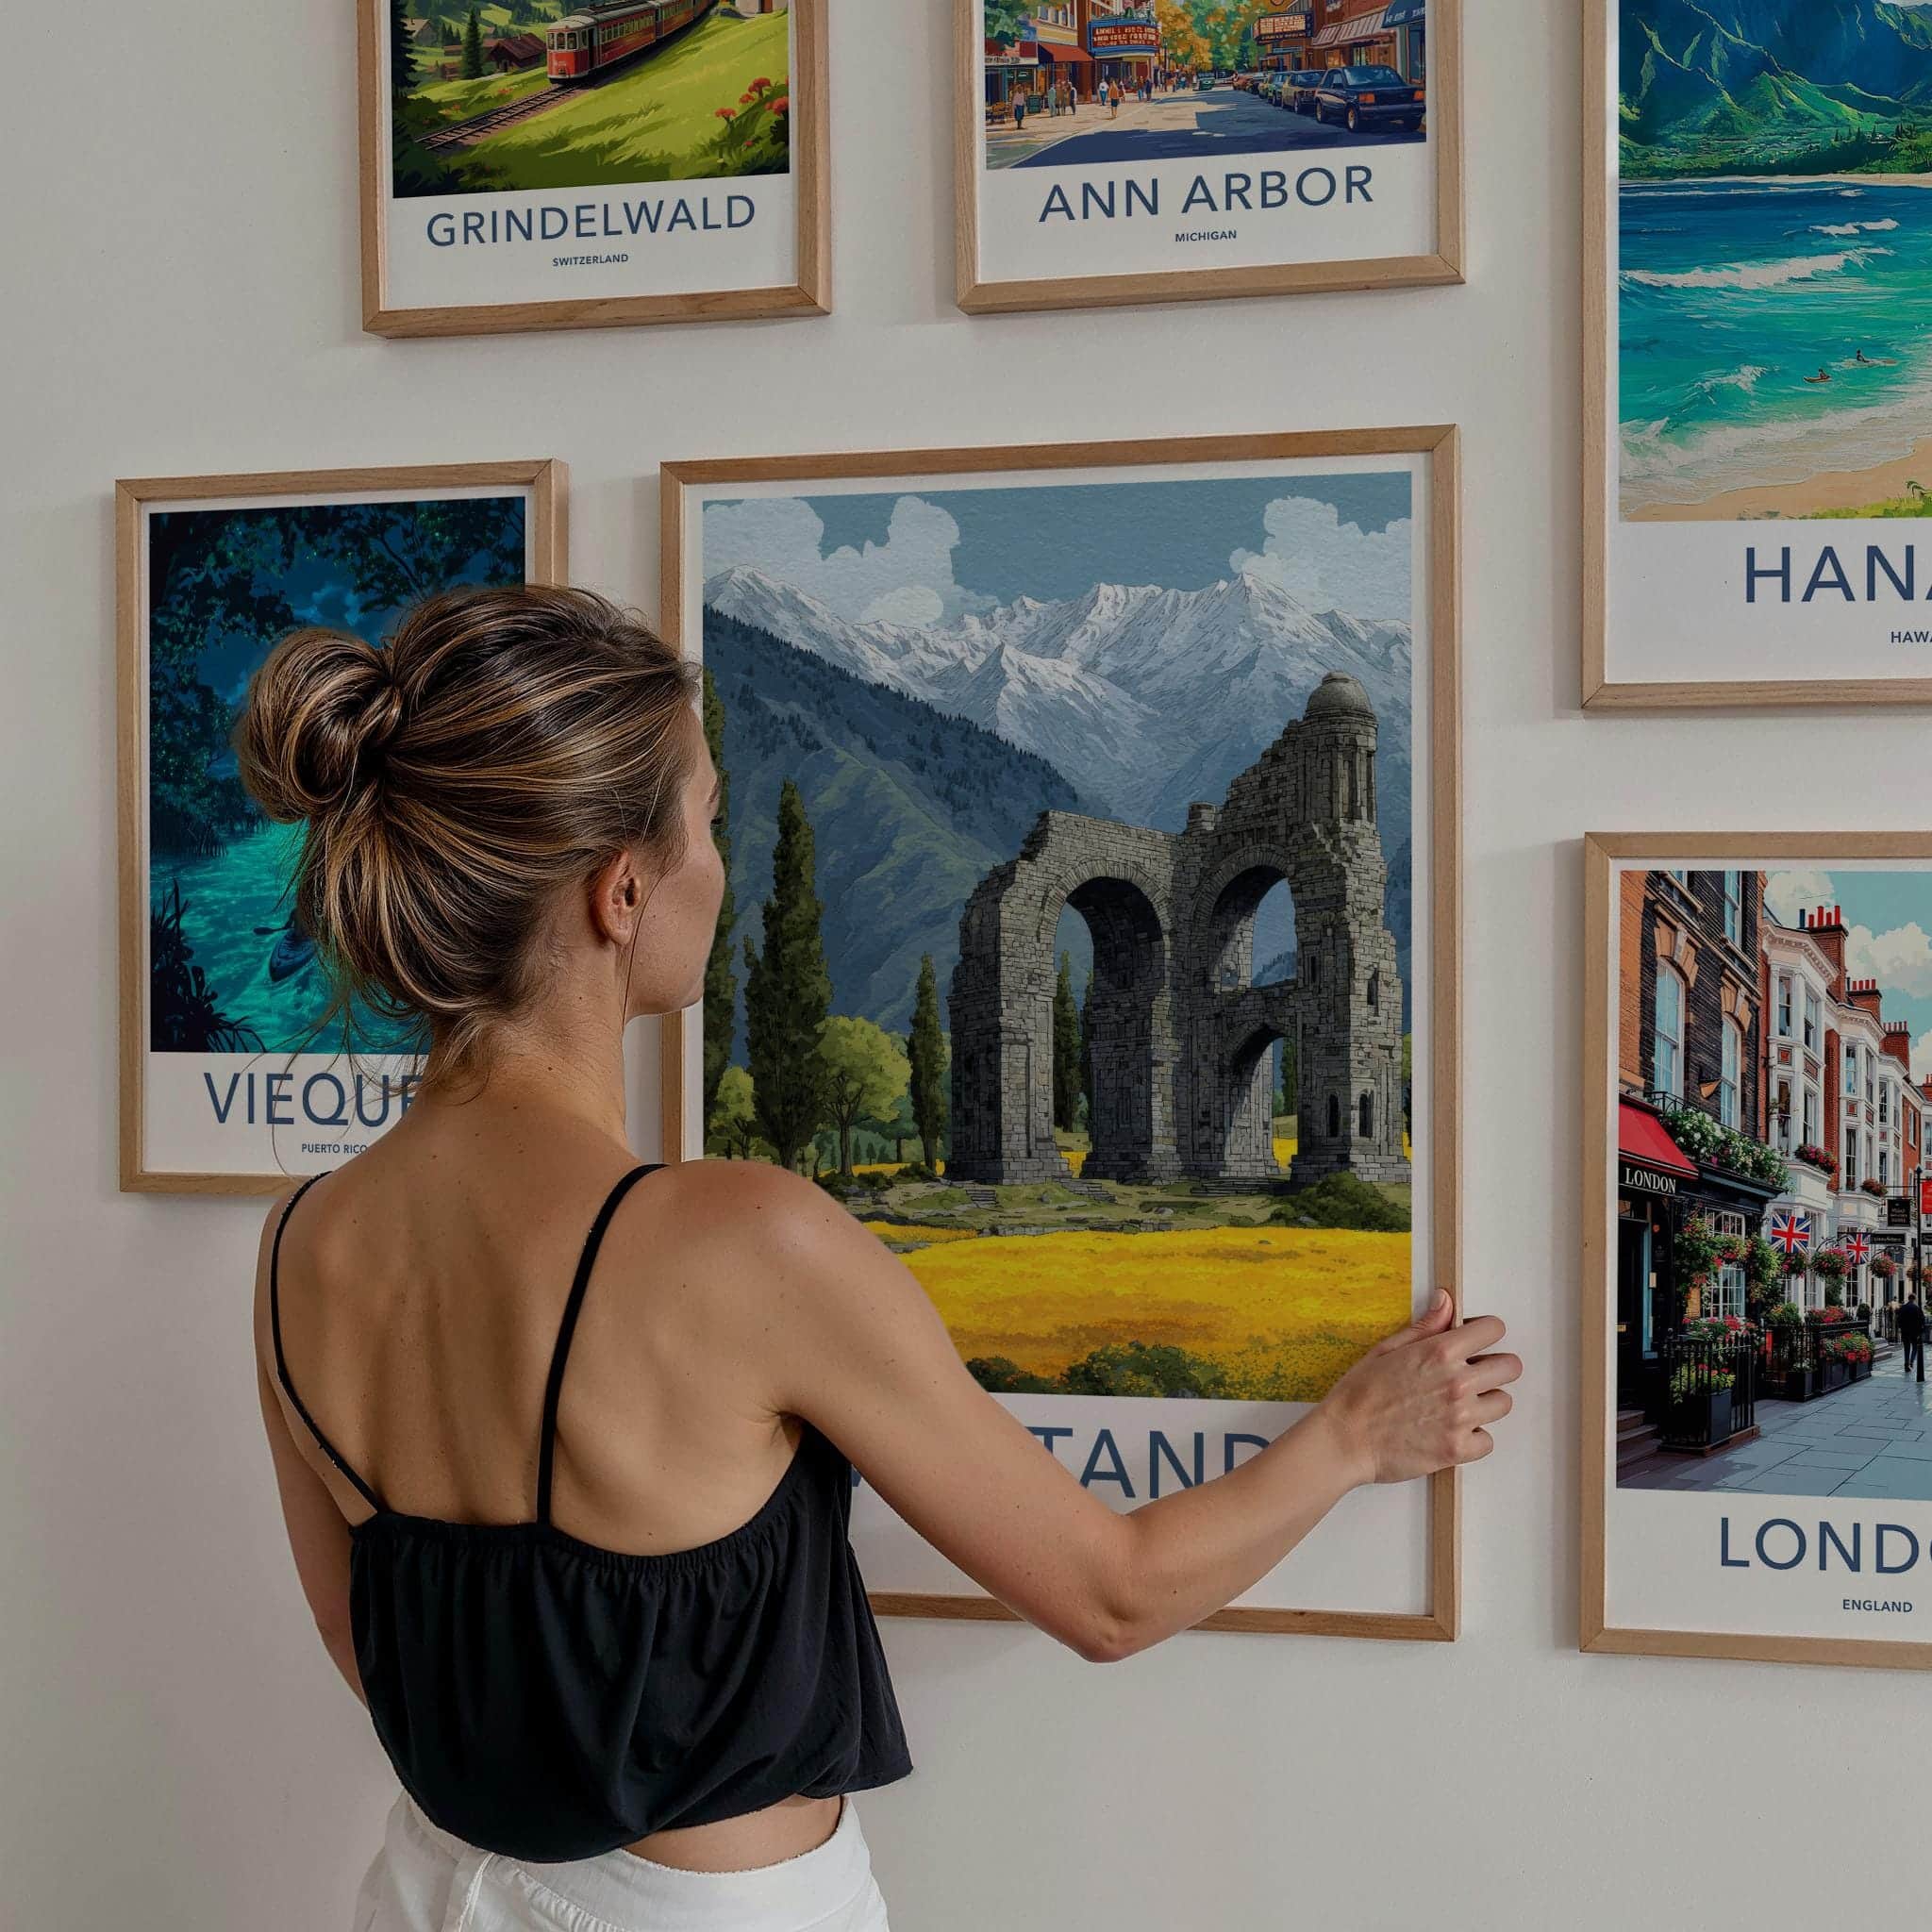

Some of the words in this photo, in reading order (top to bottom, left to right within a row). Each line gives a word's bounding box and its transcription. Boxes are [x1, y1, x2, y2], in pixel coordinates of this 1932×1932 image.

[1039, 178, 1158, 222] ANN
[1181, 165, 1373, 213] ARBOR
[426, 195, 756, 247] GRINDELWALD
[1174, 229, 1237, 242] MICHIGAN
[552, 254, 629, 267] SWITZERLAND
[1746, 544, 1932, 603] HAN
[1890, 631, 1932, 643] HAW
[301, 1143, 341, 1154] PUERTO
[343, 1144, 367, 1154] RICO
[1625, 1167, 1676, 1193] LONDON
[1721, 1517, 1932, 1574] LOND
[1842, 1599, 1913, 1613] ENGLAND
